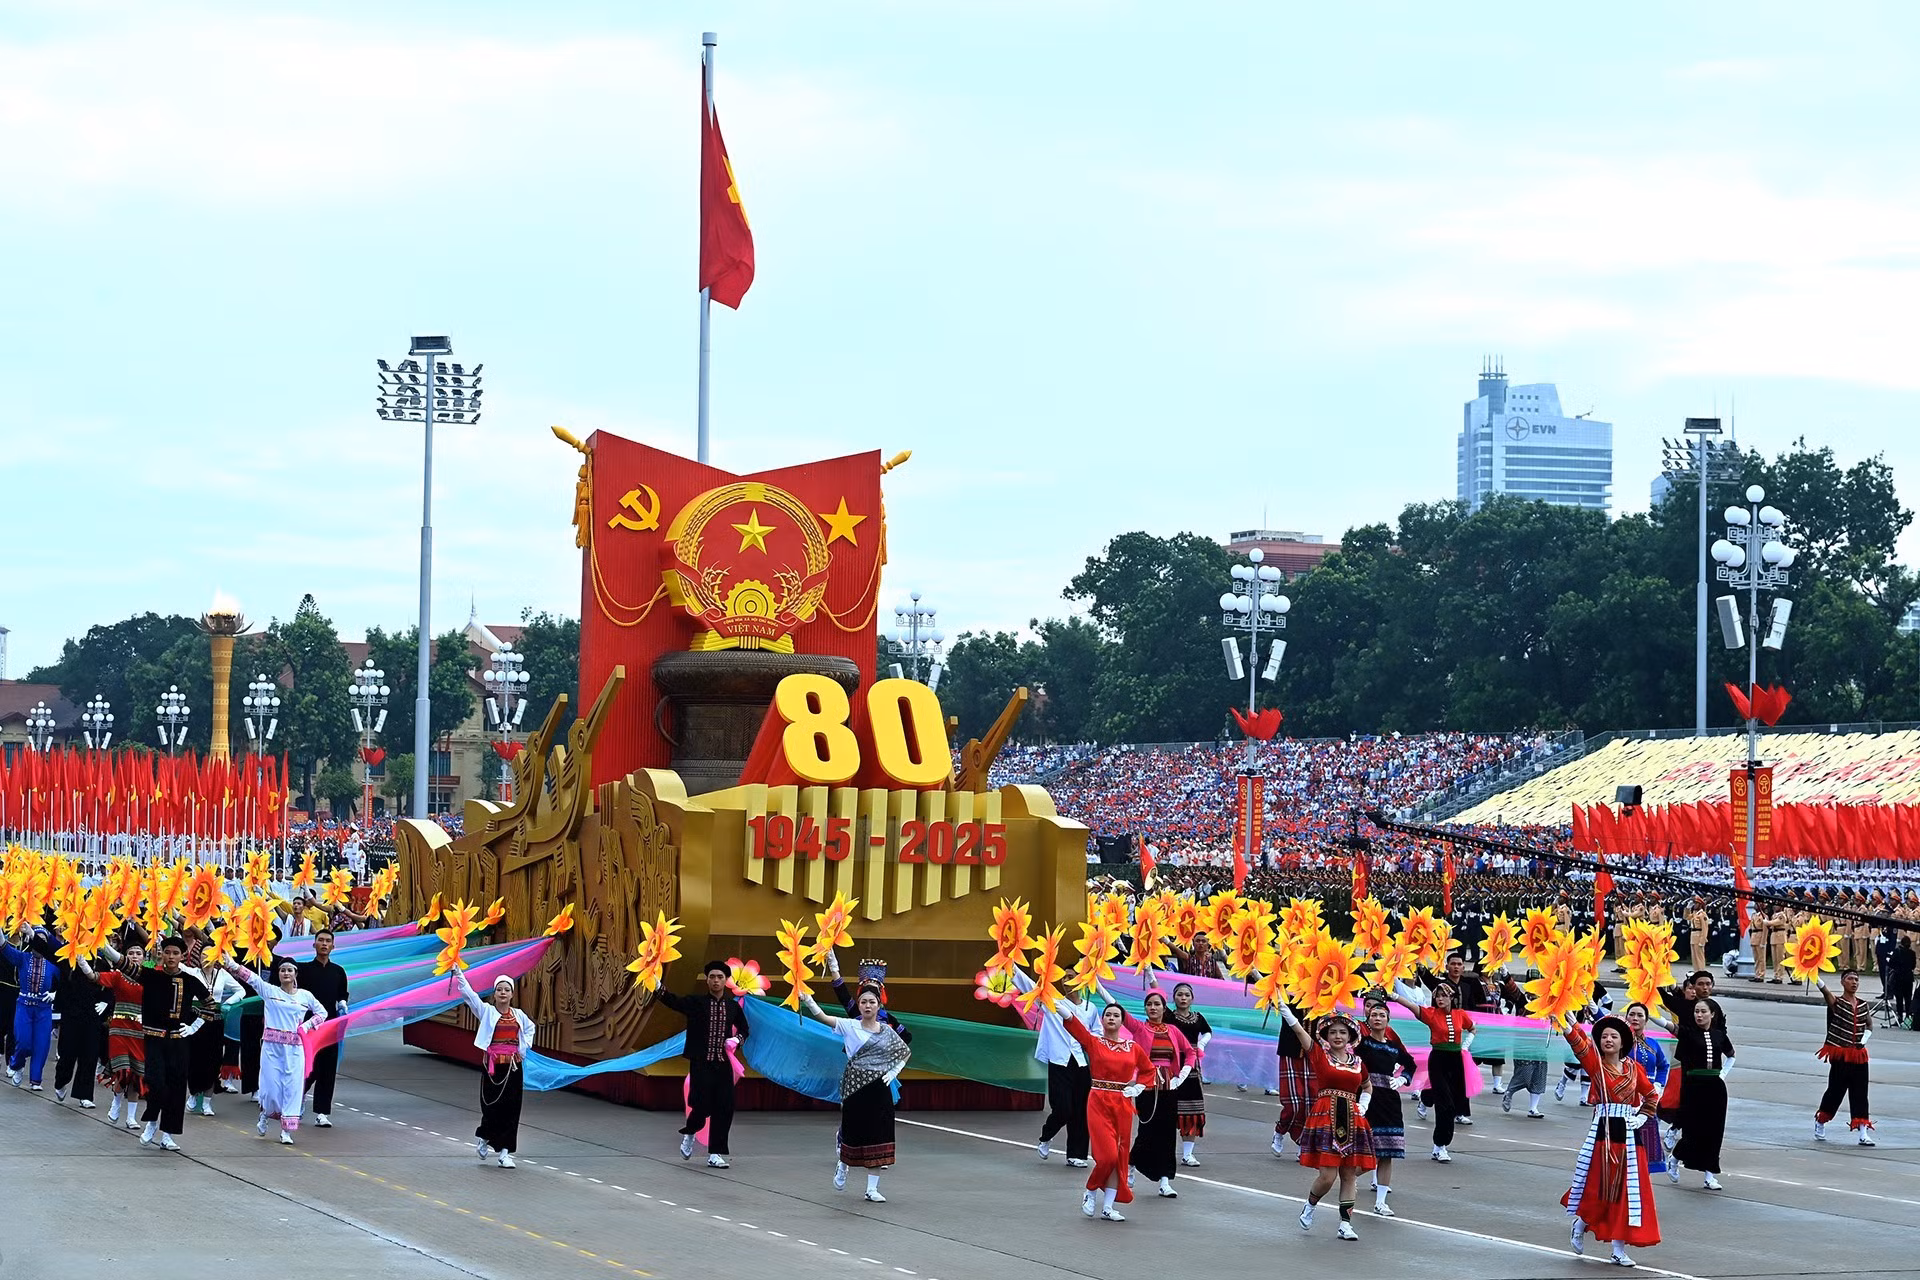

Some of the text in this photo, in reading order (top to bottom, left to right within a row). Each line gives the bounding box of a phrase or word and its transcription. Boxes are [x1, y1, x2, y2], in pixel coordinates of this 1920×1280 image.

[1532, 424, 1556, 434] EVN
[727, 622, 776, 636] VIỆT NAM
[775, 673, 953, 785] 80
[748, 815, 851, 861] 1945
[899, 820, 1008, 866] 2025
